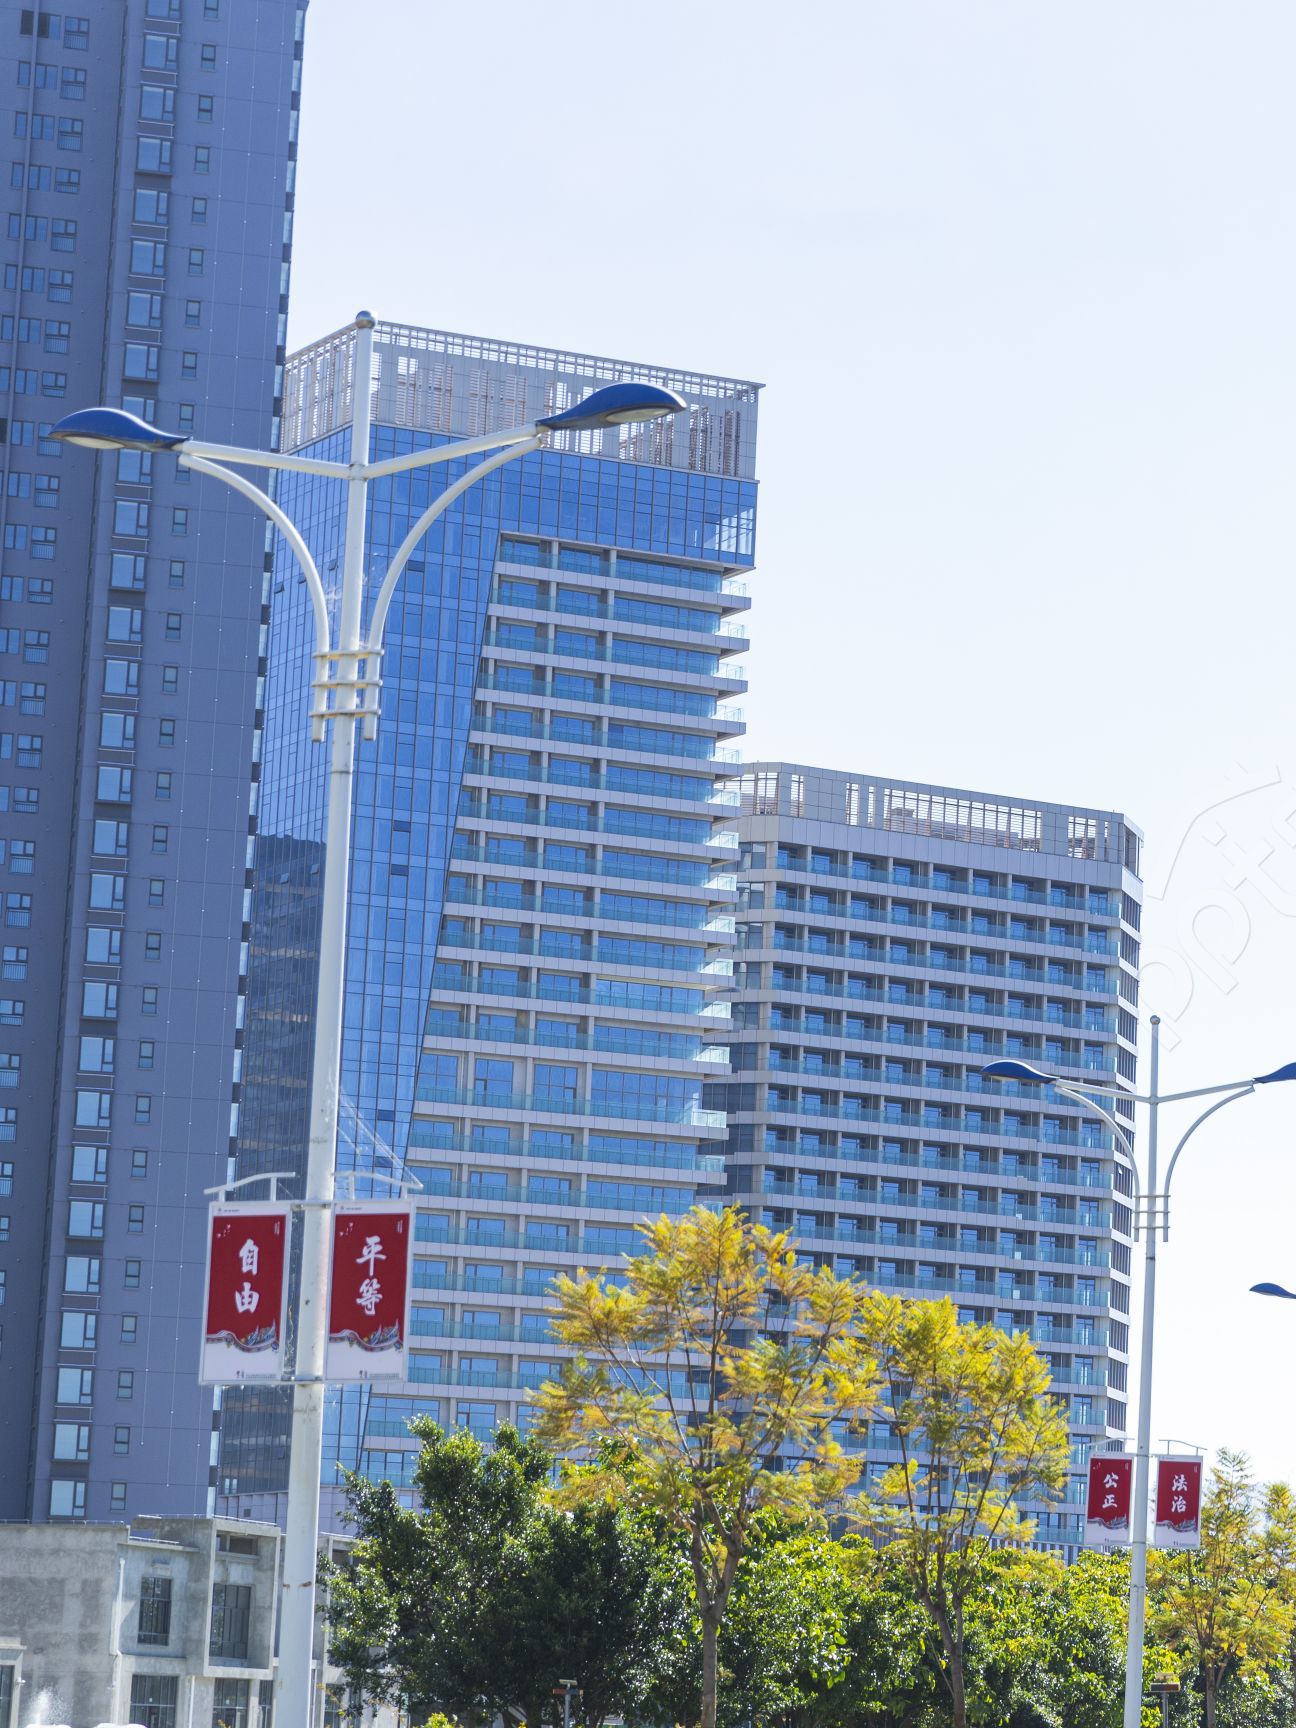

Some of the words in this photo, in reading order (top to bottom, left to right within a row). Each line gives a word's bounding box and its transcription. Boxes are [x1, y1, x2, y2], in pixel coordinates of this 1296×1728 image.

[235, 1238, 260, 1314] 自由
[356, 1235, 387, 1316] 平等
[1102, 1472, 1119, 1509] 公正
[1171, 1474, 1188, 1513] 法治
